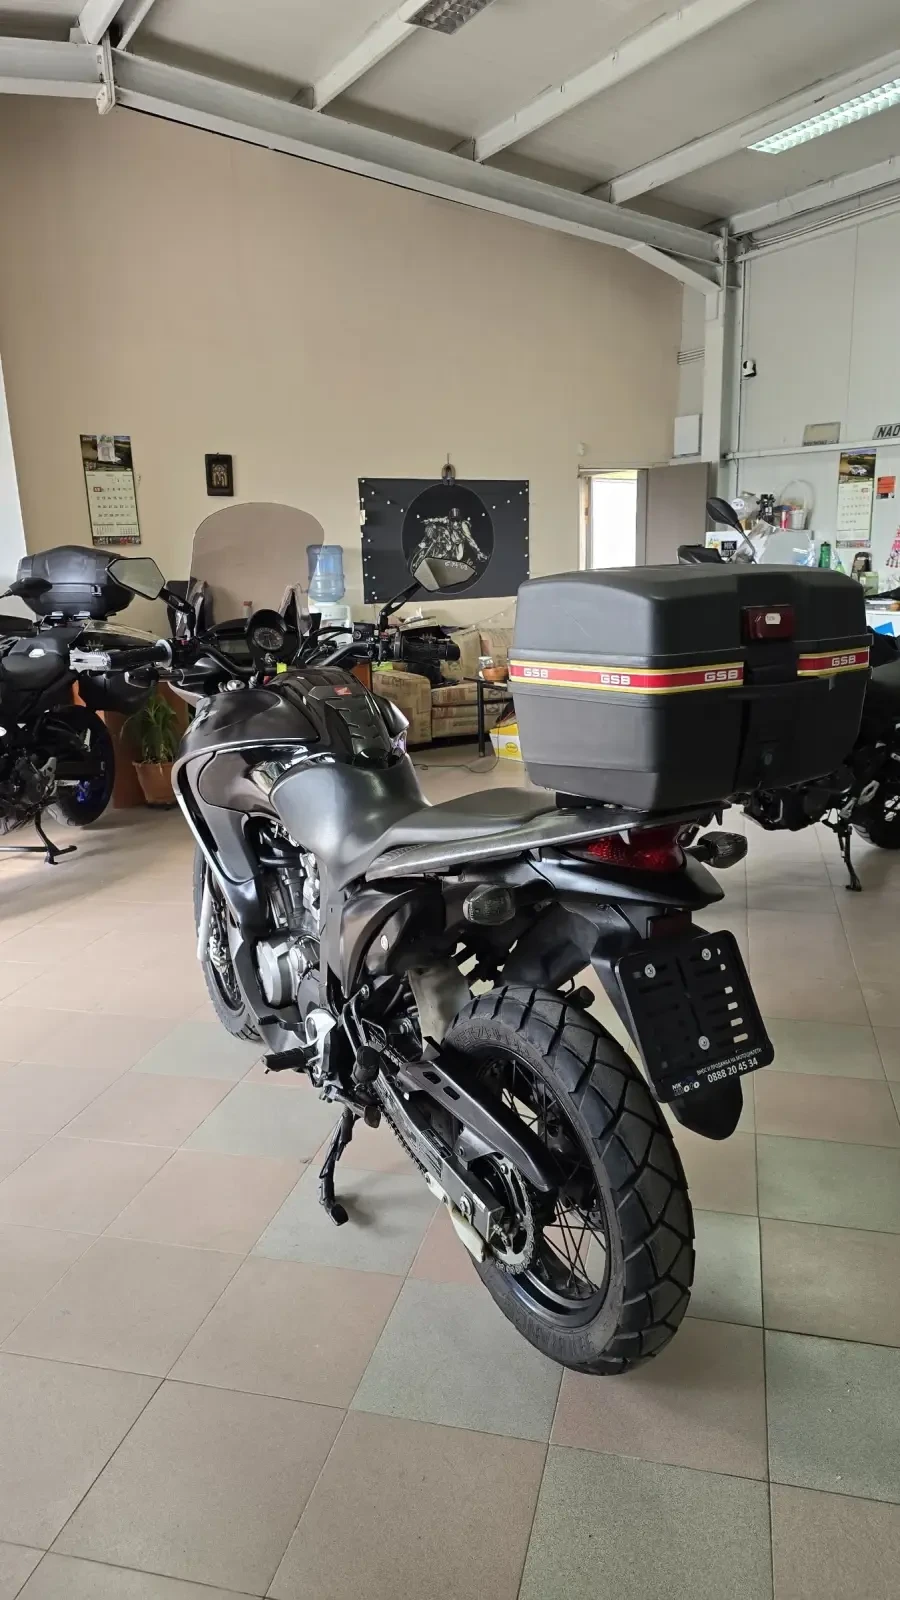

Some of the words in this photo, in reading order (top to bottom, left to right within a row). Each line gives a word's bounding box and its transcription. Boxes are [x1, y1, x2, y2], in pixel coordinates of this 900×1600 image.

[831, 655, 856, 667] GSB
[523, 668, 548, 678] GSB
[600, 674, 631, 685] GSB
[704, 670, 738, 682] GSB
[707, 1069, 727, 1083] 0888
[727, 1065, 737, 1075] 20
[738, 1061, 748, 1071] 45
[748, 1057, 758, 1068] 34
